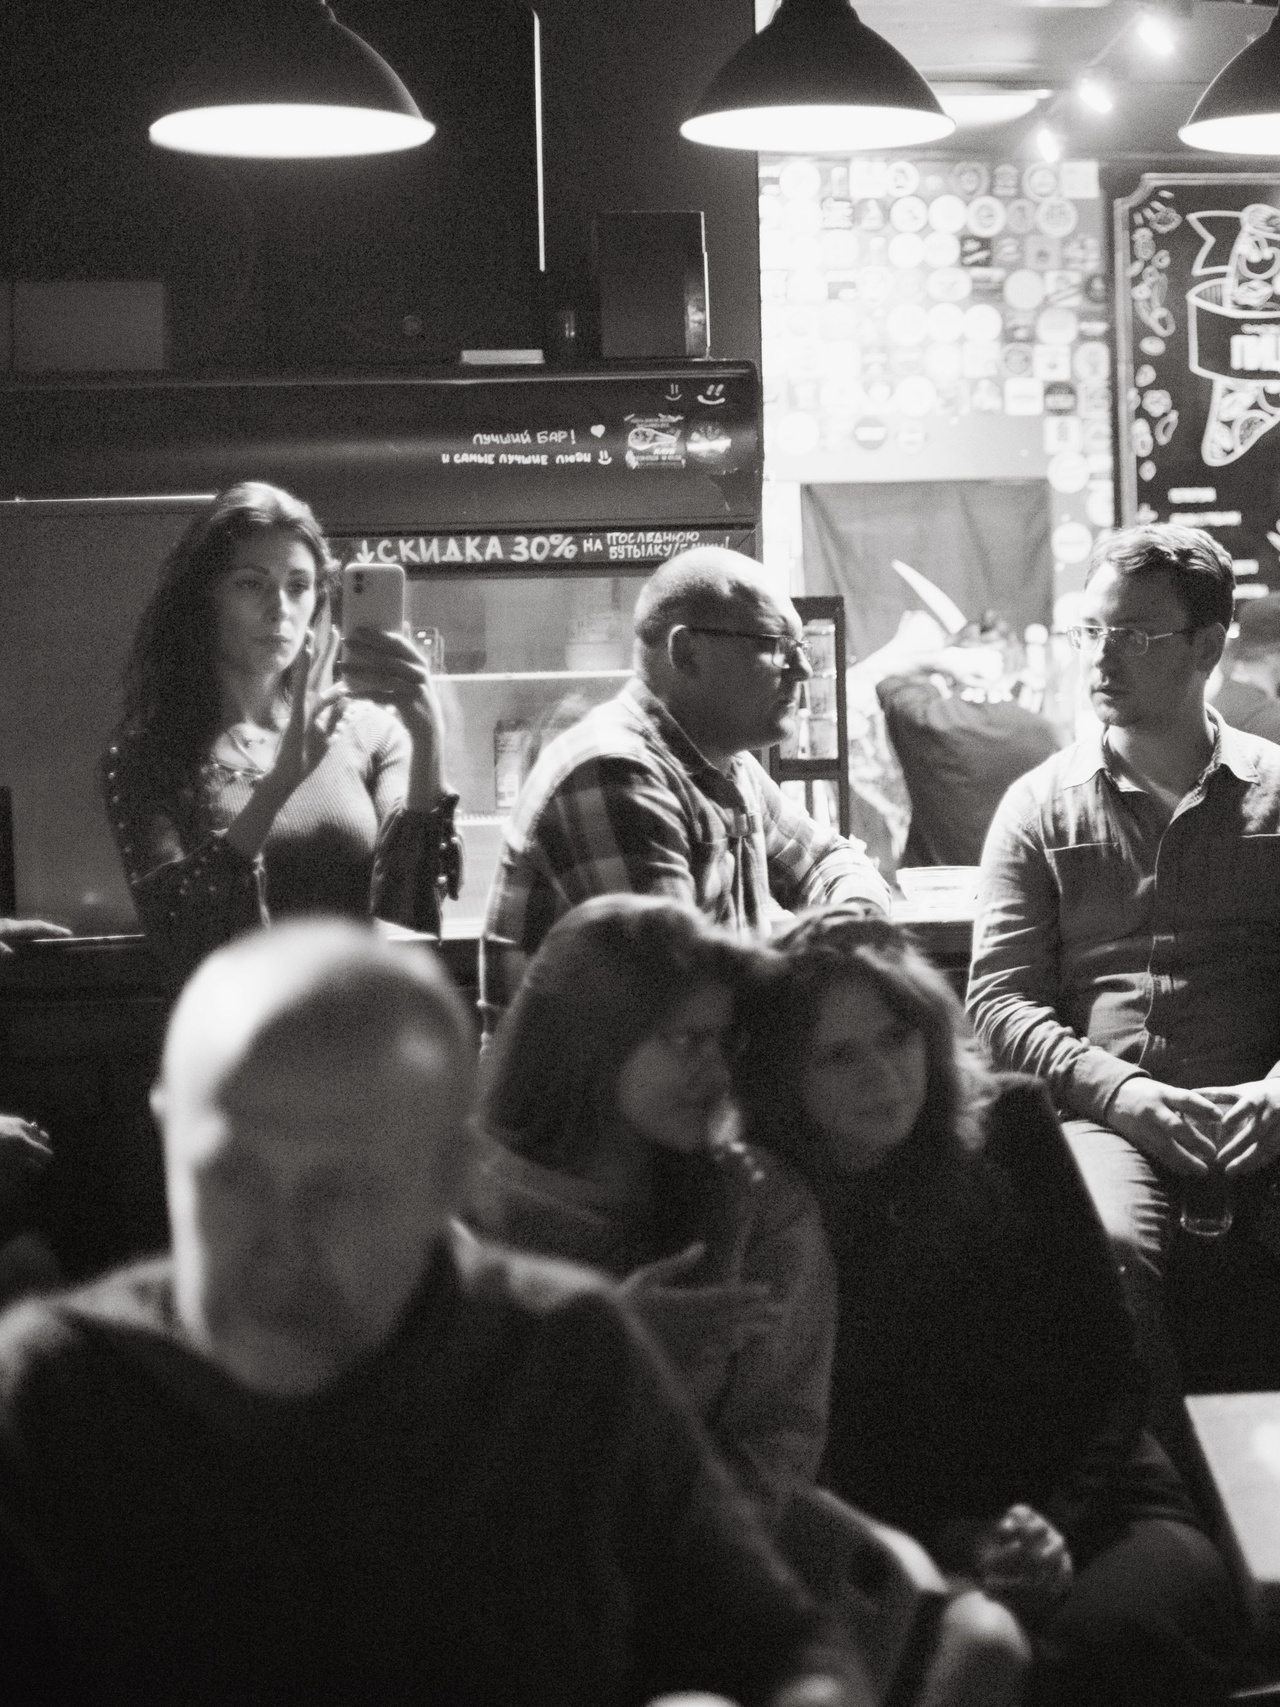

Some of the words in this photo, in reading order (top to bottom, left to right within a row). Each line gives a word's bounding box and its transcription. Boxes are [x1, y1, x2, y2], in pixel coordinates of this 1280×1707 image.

[472, 429, 532, 445] ЛУЧШИЙ
[536, 429, 577, 445] БАР!
[499, 453, 548, 465] ЛУЧШИЕ
[606, 531, 700, 545] ПОСЛЕДНЮЮ
[377, 535, 504, 563] СКИДКА
[510, 534, 578, 562] 30%
[583, 538, 603, 553] НА
